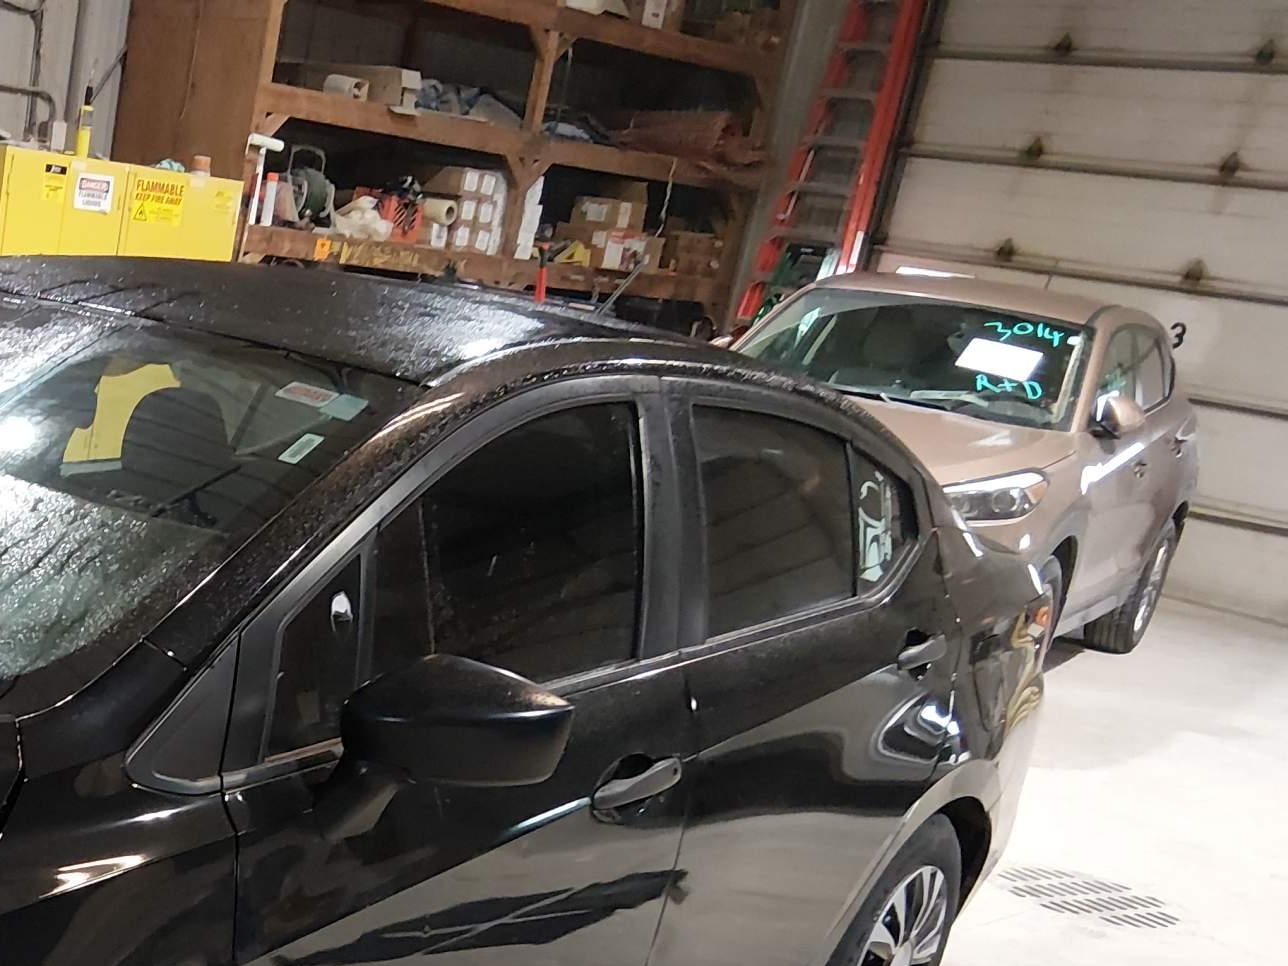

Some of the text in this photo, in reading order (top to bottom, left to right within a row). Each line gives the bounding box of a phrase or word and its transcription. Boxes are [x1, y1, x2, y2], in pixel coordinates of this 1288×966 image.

[137, 179, 184, 197] FLAMMABLE
[135, 193, 183, 206] KEEP FIRE AWAY
[984, 322, 1065, 348] 3014
[1170, 322, 1188, 349] 3
